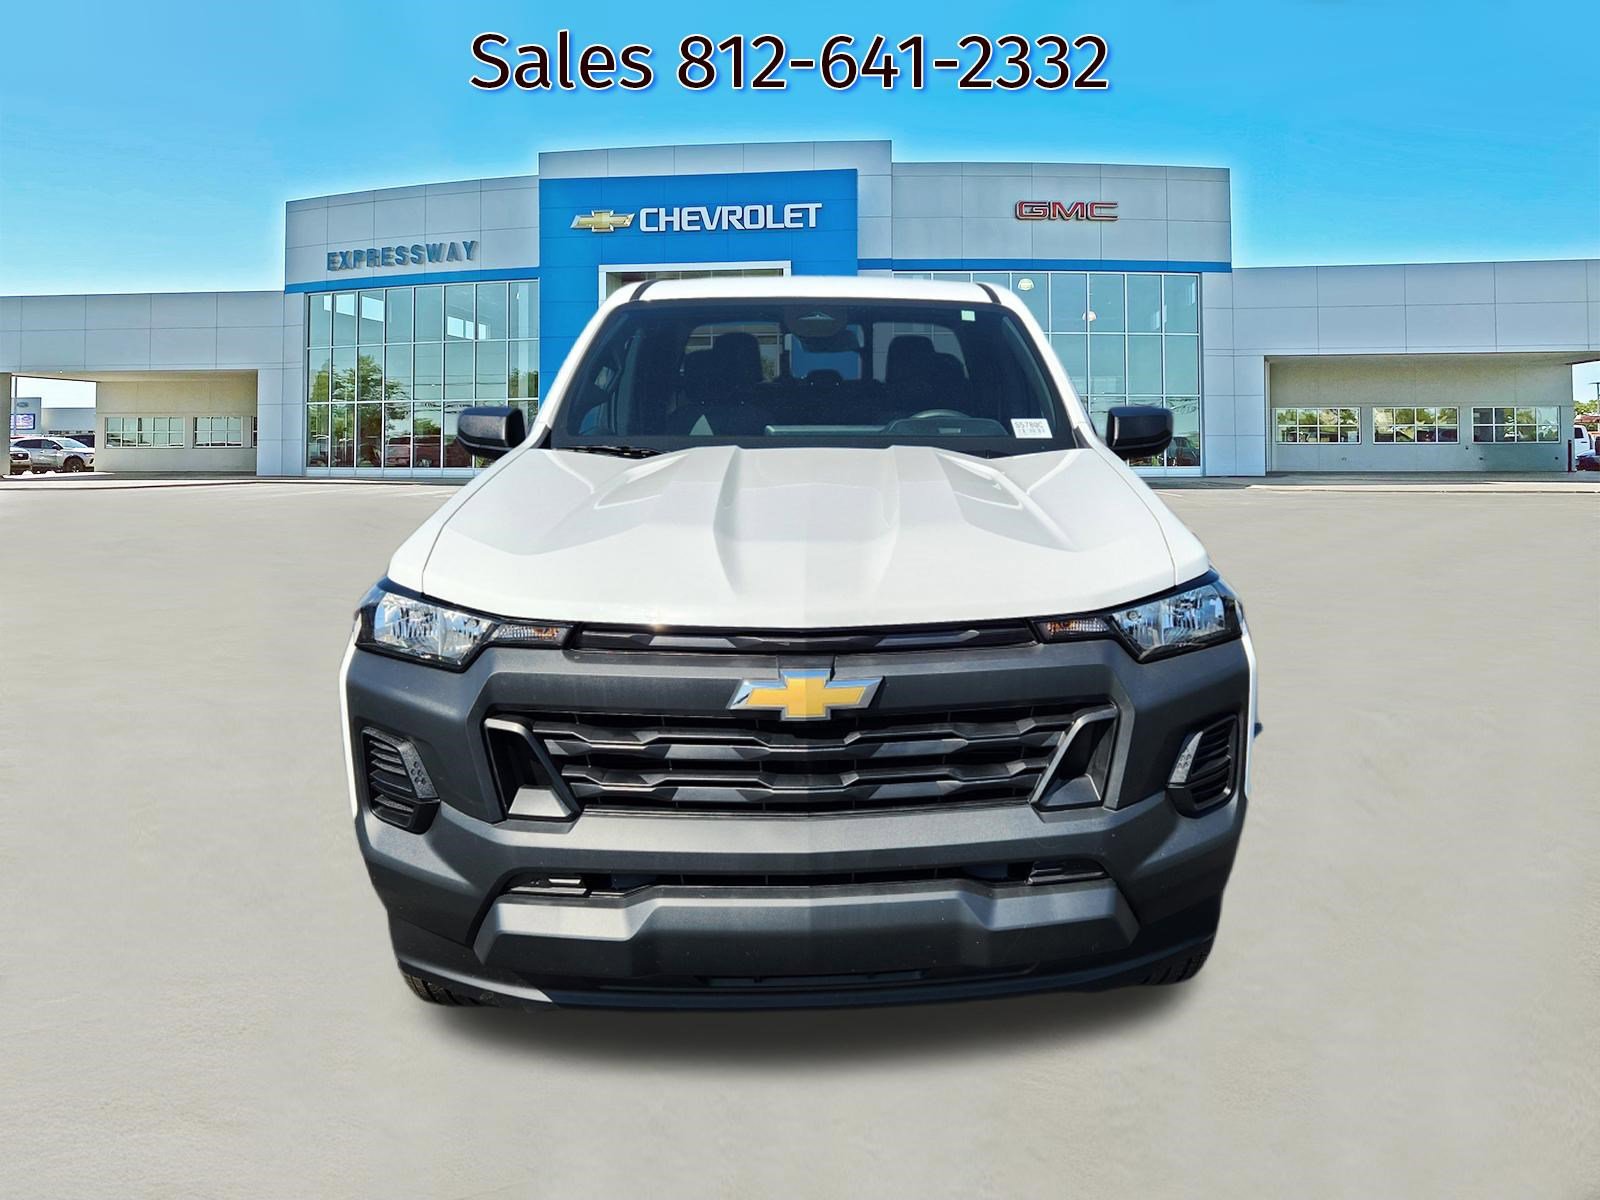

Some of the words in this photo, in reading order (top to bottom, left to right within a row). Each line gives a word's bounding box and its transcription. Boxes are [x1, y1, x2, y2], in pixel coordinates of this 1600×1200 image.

[639, 203, 822, 232] CHEVROLET
[1015, 200, 1119, 221] GMC
[327, 240, 479, 271] EXPRESSWAY
